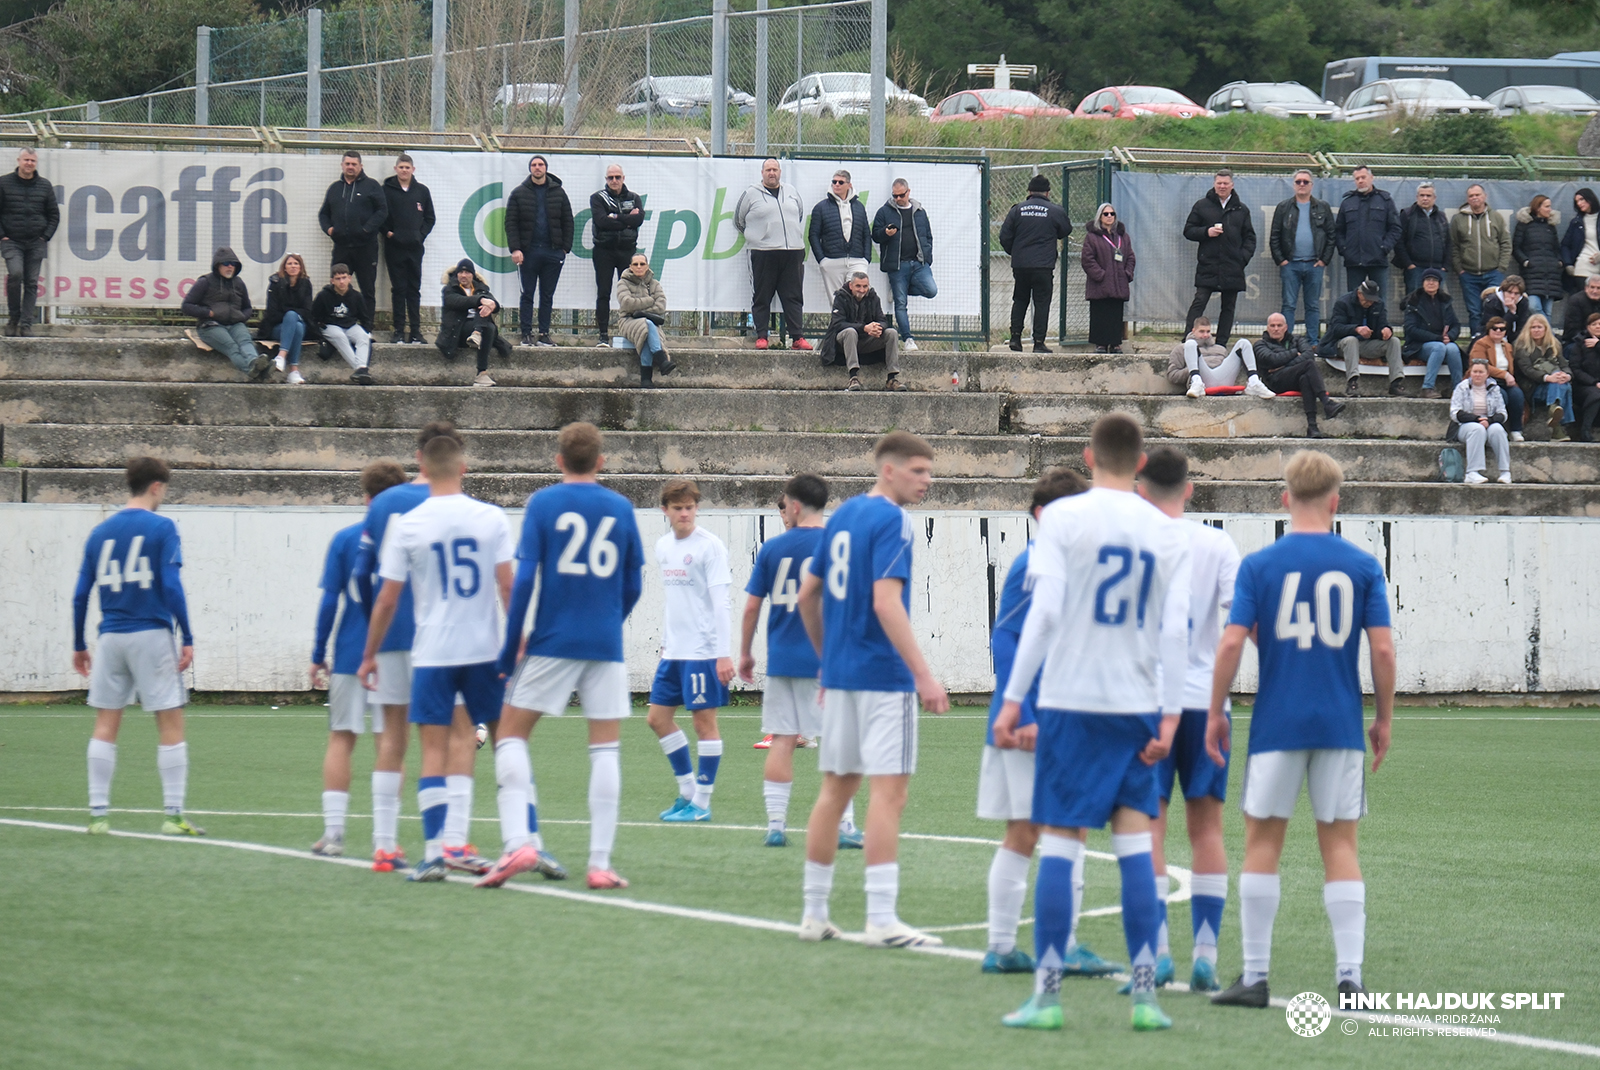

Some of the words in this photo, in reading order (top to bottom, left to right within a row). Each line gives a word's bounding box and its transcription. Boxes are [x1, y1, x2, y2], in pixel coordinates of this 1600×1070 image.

[4, 275, 199, 298] SPRESSO
[97, 534, 154, 593] 44
[430, 537, 481, 600] 15
[555, 512, 619, 578] 26
[663, 569, 687, 577] TOYOTA
[827, 530, 851, 600] 8
[1093, 545, 1156, 630] 21
[1275, 570, 1354, 650] 40
[690, 672, 706, 695] 11
